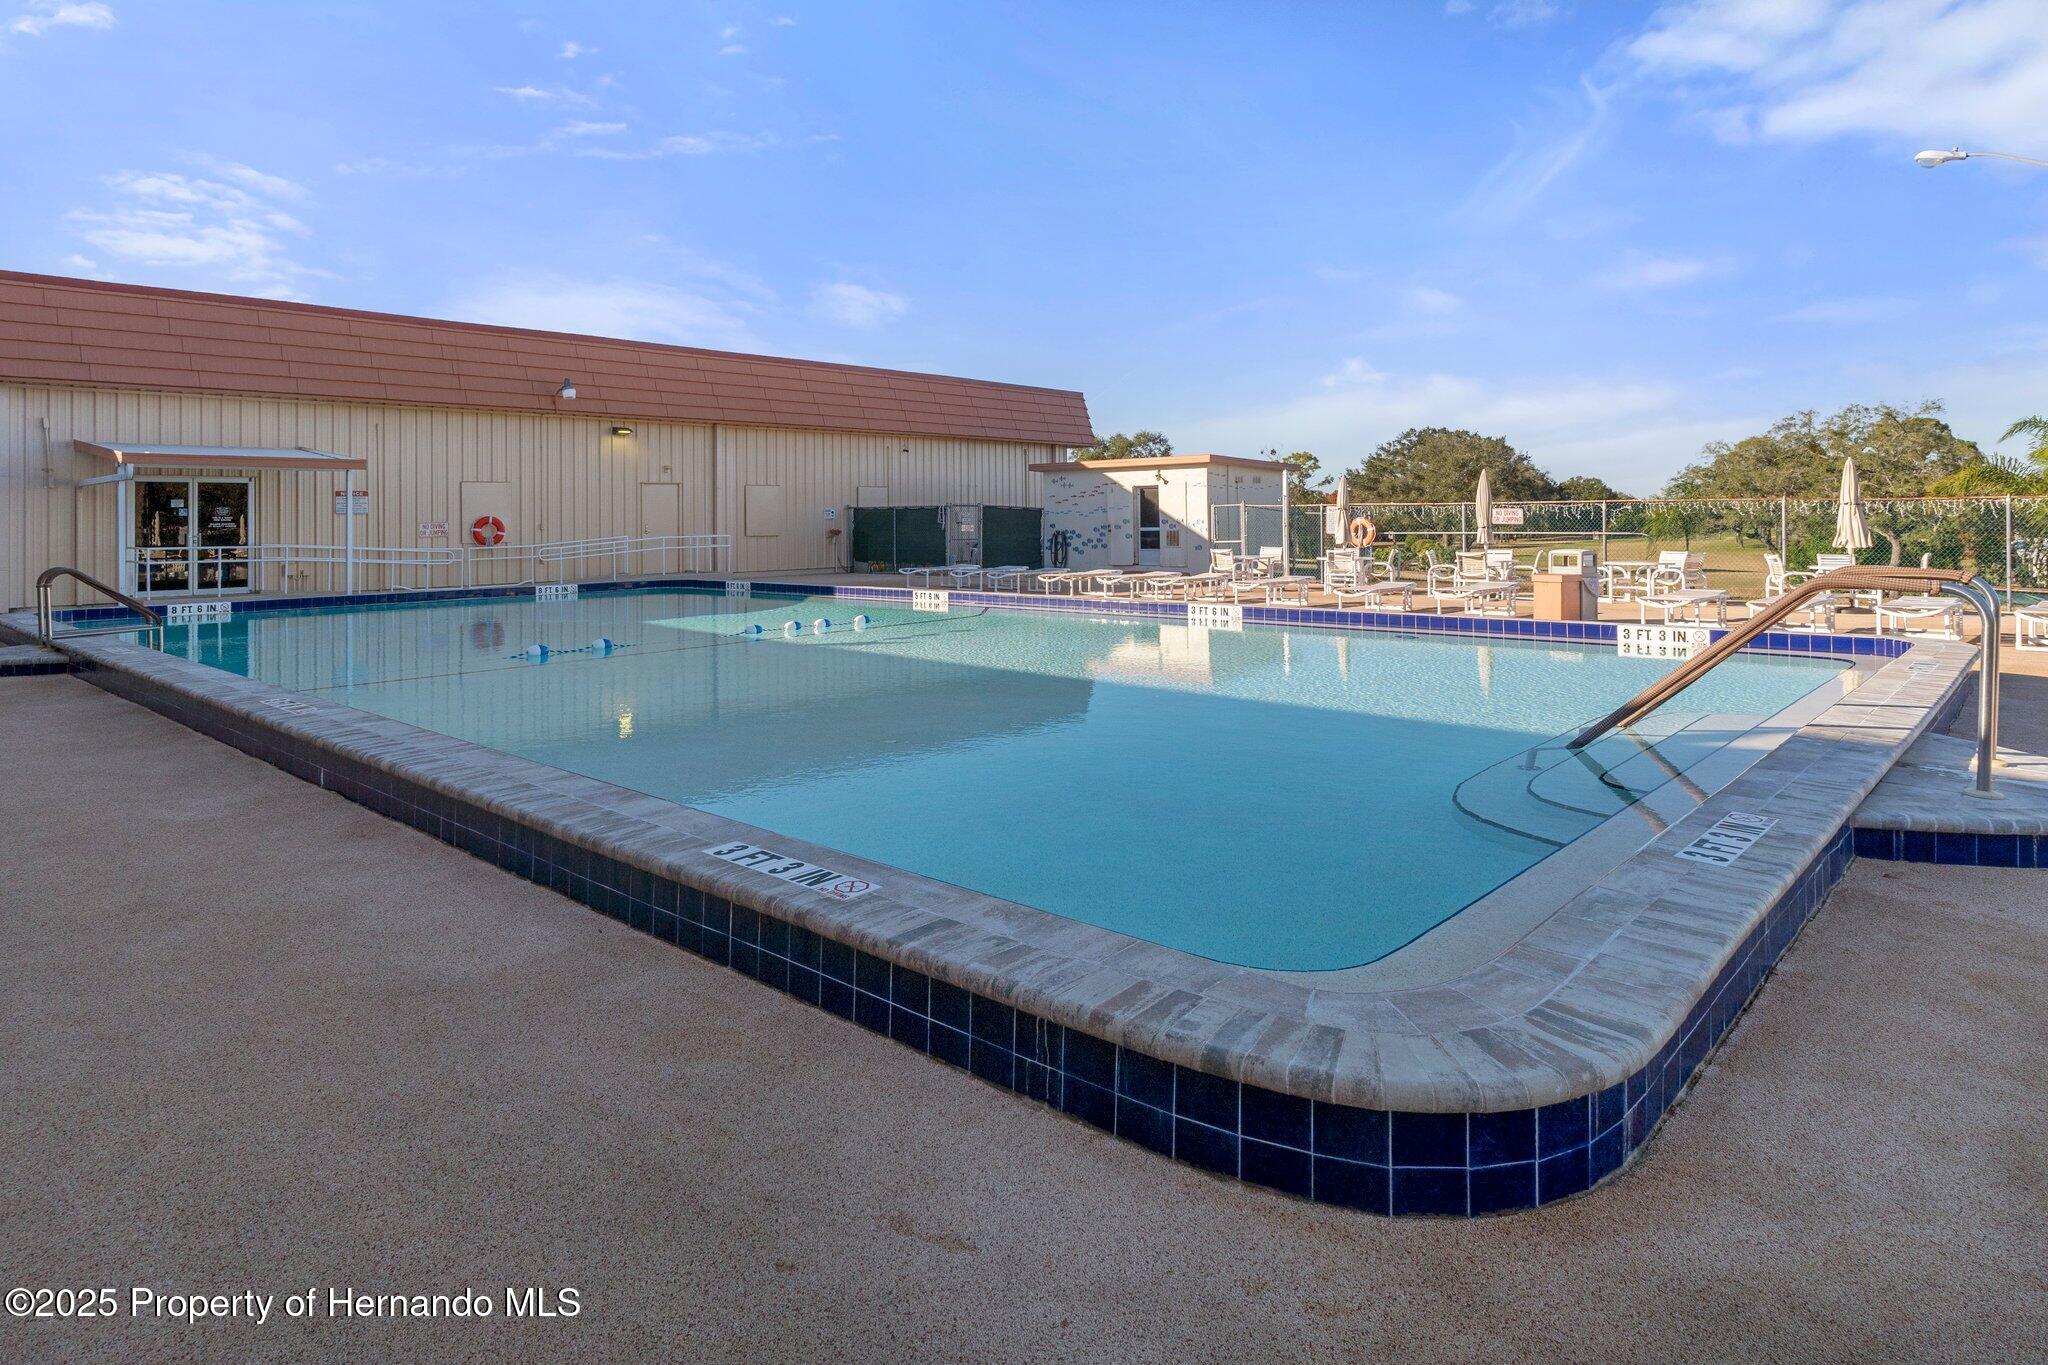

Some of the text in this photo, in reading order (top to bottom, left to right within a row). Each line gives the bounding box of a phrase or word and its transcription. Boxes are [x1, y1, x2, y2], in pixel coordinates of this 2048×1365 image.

[171, 606, 177, 614] 8
[197, 605, 203, 613] 6
[1191, 606, 1196, 614] 3
[1212, 607, 1217, 616] 6
[1623, 628, 1689, 643] 3 FT. 3 IN.
[1715, 820, 1766, 836] IN
[1708, 831, 1753, 842] 3
[1691, 838, 1744, 855] FT
[1682, 850, 1730, 863] 3
[712, 844, 843, 887] 3 FT 3 IN
